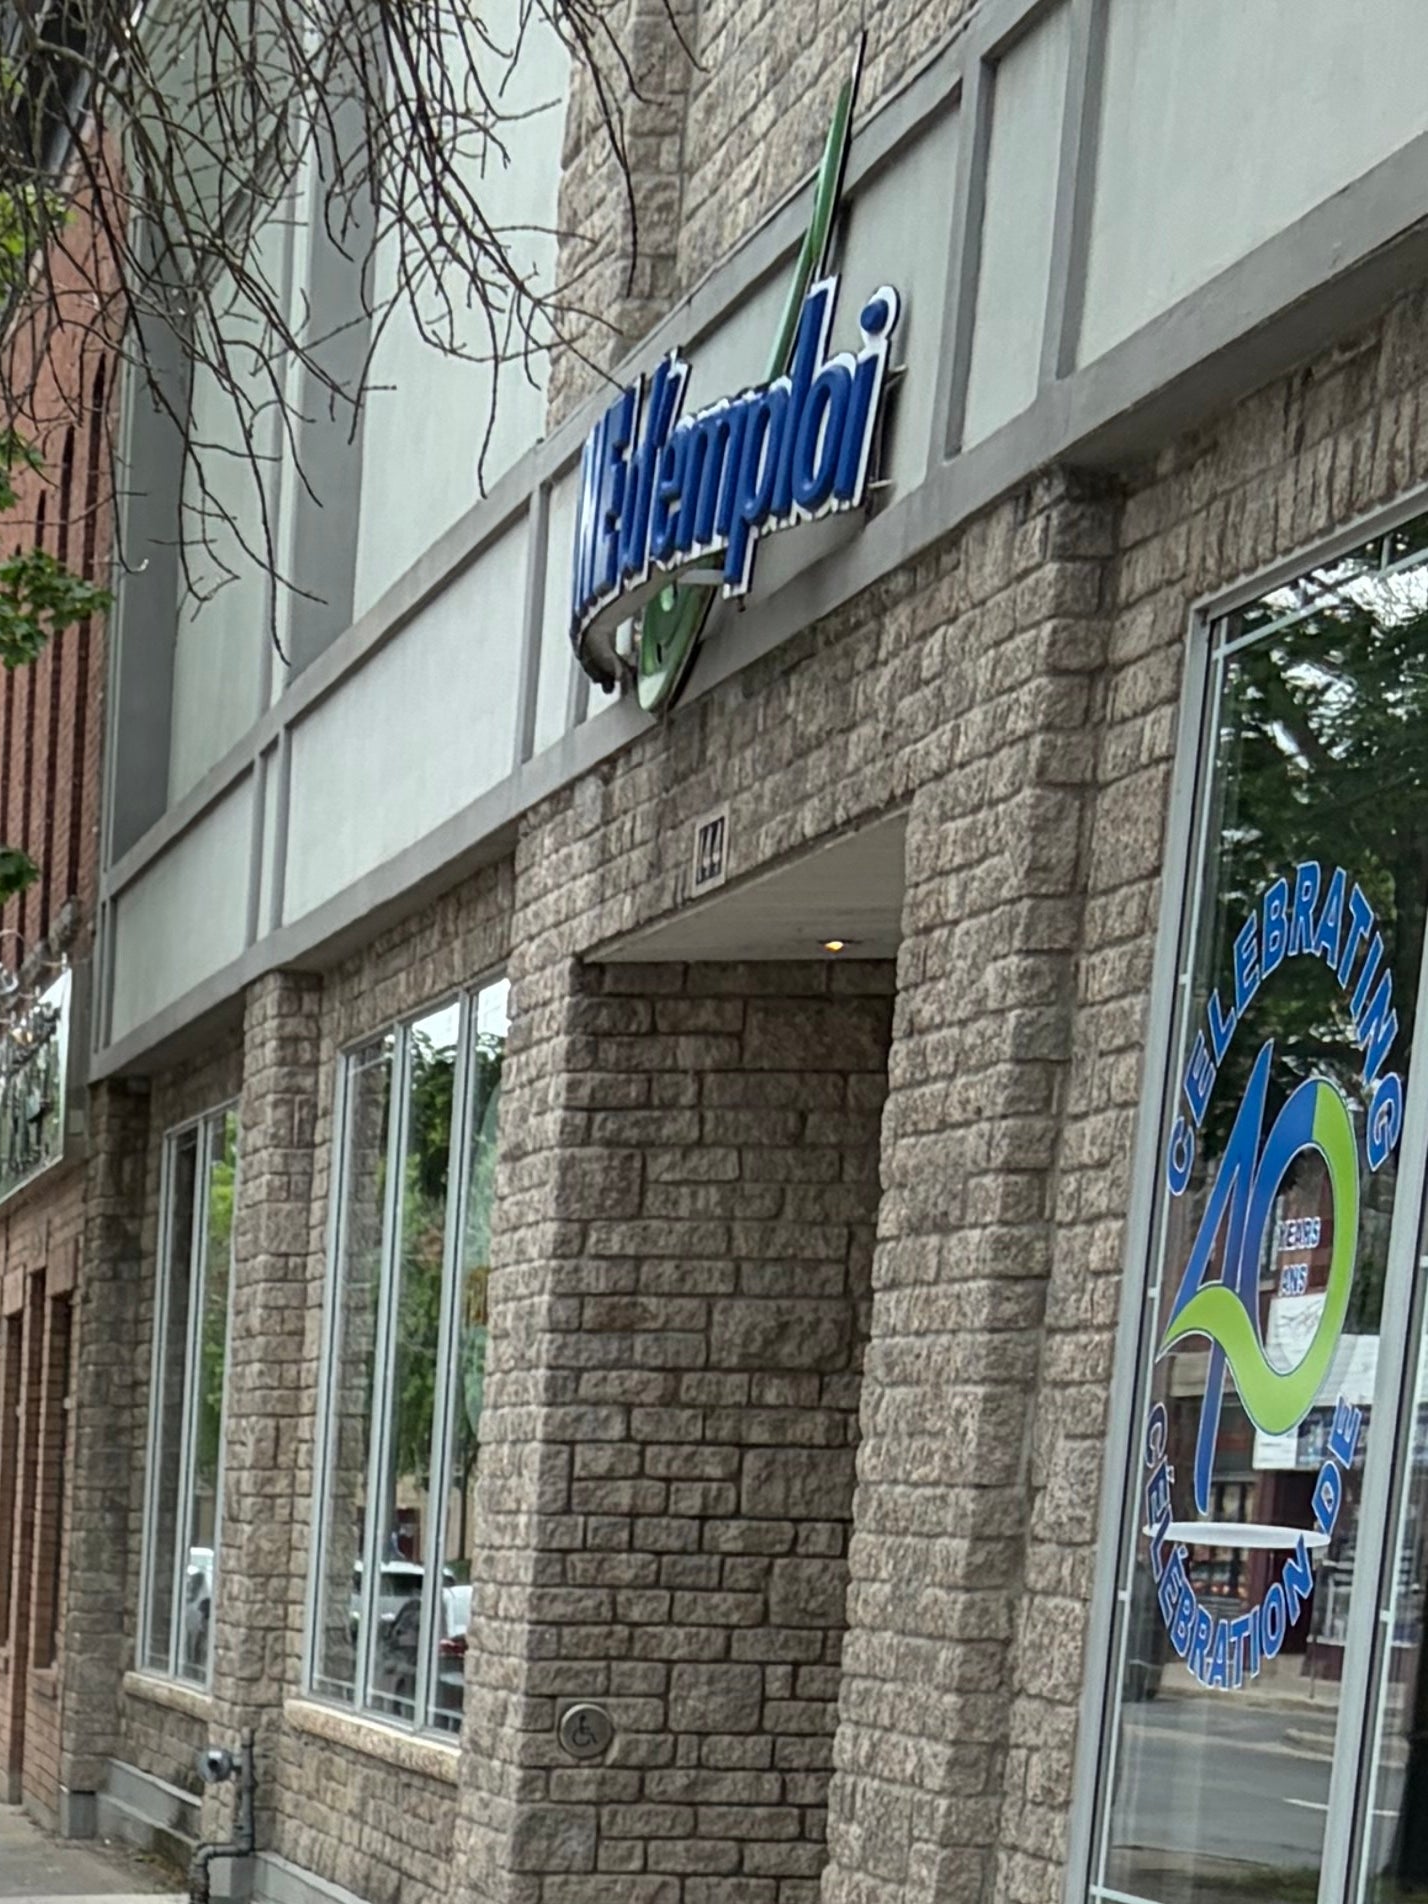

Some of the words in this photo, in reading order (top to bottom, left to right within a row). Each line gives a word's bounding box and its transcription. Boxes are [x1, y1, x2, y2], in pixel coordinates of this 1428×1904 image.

[1166, 860, 1403, 1196] CELEBRATING
[1278, 1216, 1321, 1252] YEARS
[1278, 1263, 1309, 1297] ANS
[1312, 1392, 1362, 1537] DE
